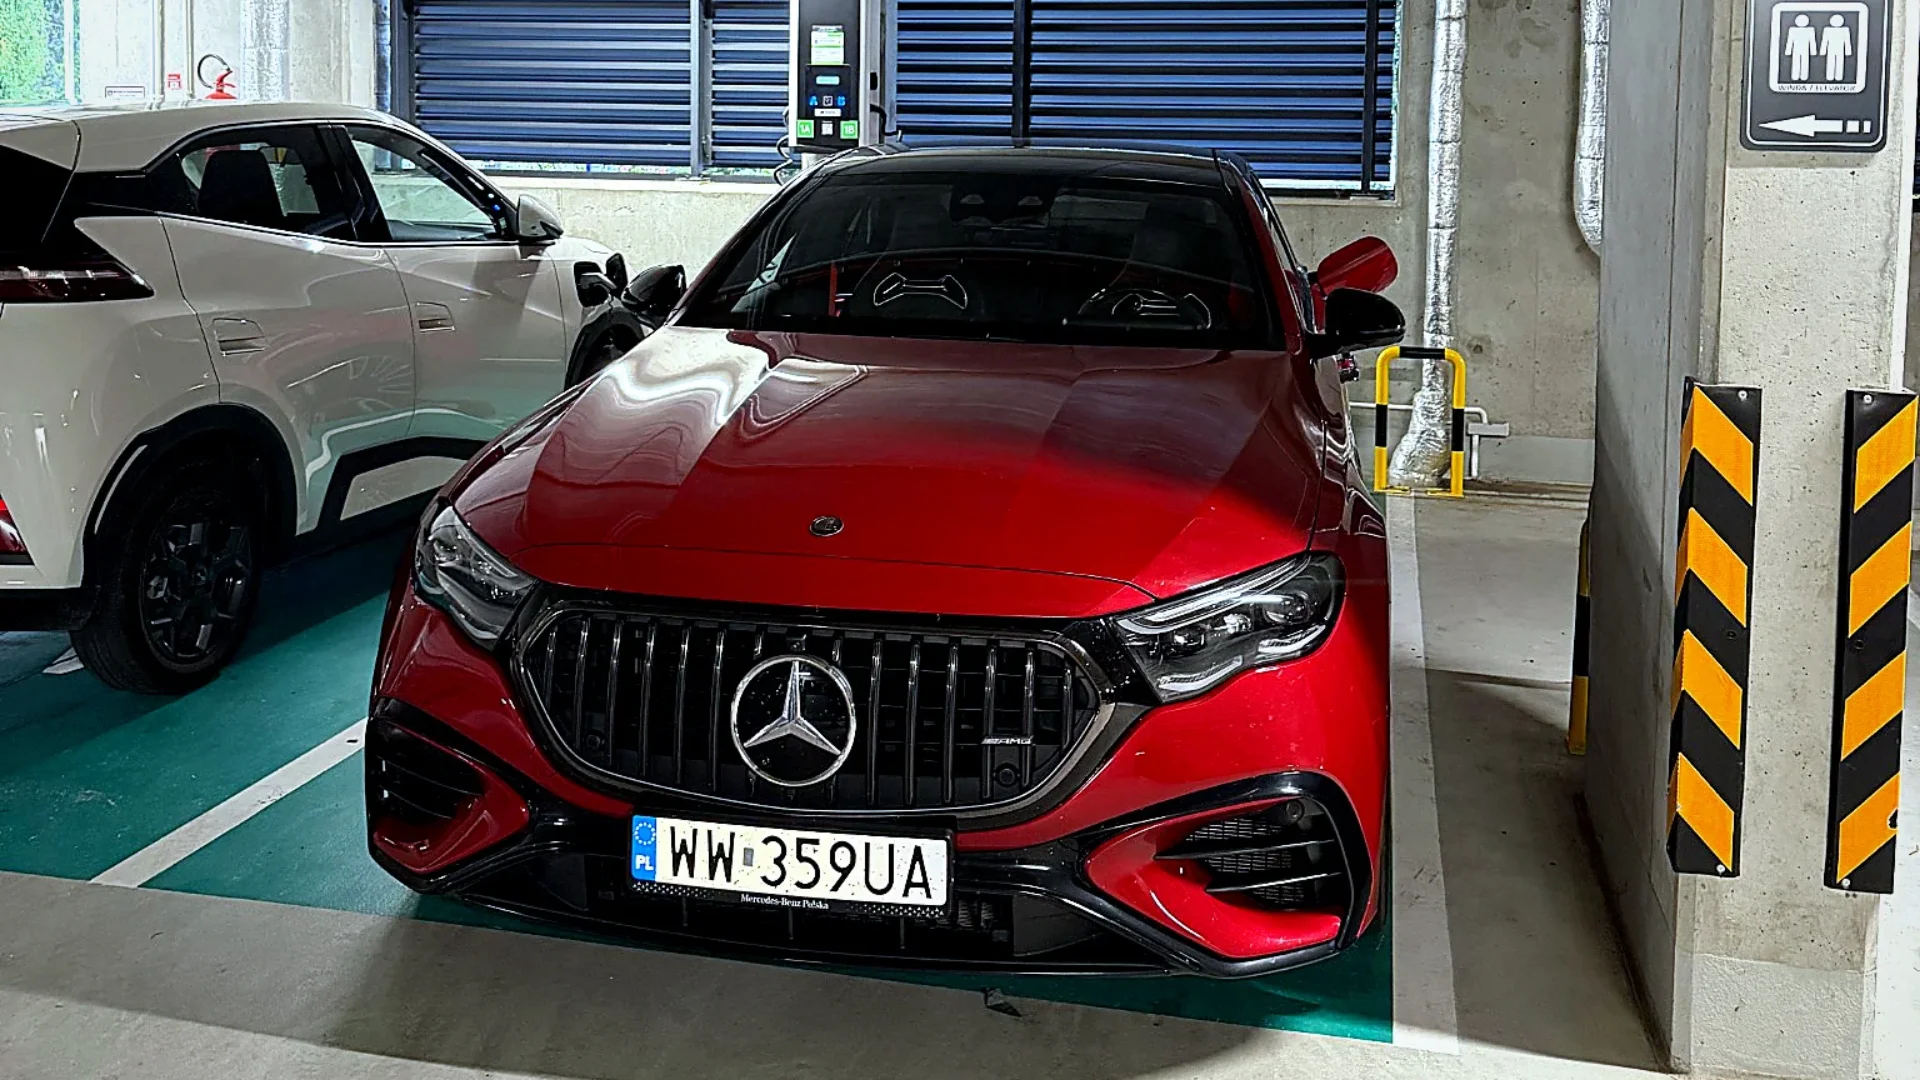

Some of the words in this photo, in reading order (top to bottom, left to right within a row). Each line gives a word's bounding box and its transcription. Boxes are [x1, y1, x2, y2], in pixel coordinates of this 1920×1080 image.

[635, 854, 654, 871] PL
[670, 826, 735, 883] WW
[760, 835, 932, 899] 359UA
[740, 893, 801, 907] Mercedes-Benz
[802, 899, 829, 910] Polska
